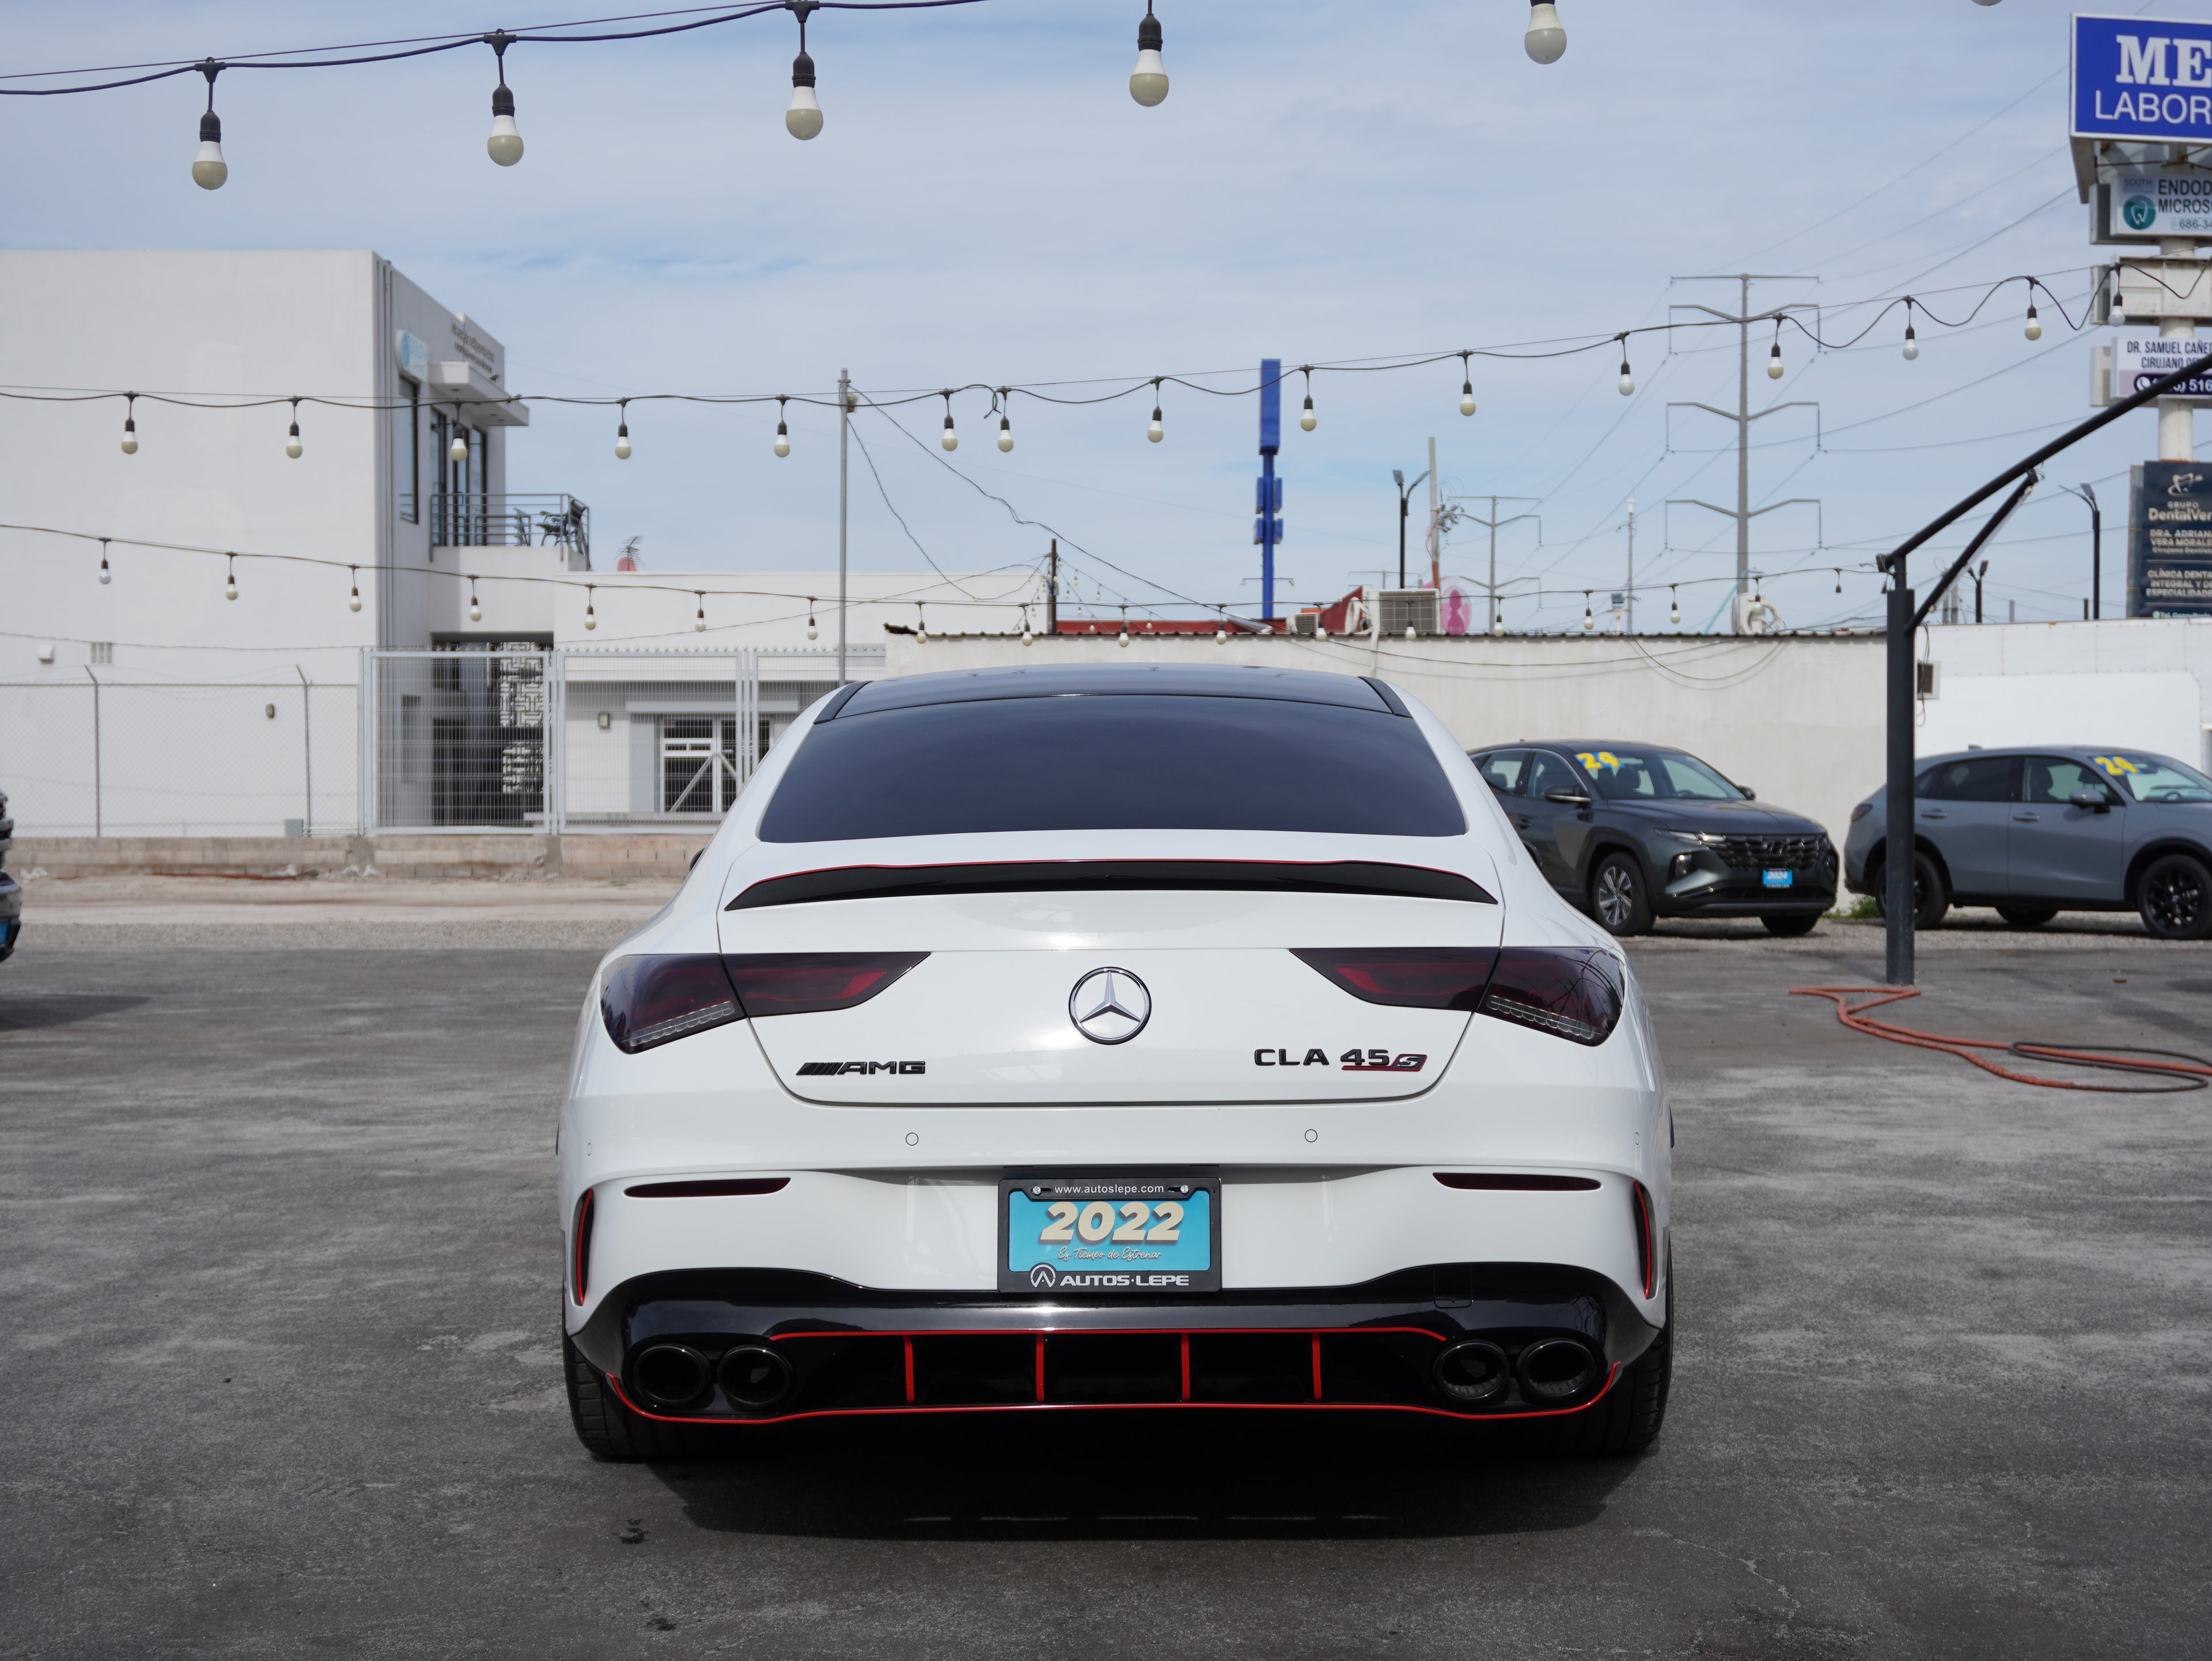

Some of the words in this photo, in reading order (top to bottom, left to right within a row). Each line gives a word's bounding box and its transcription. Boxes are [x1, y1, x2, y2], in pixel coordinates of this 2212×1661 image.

[2115, 34, 2212, 88] ME
[2095, 89, 2212, 125] LABOR
[2158, 179, 2212, 196] ENDOD
[2158, 199, 2212, 214] MICROS
[2127, 341, 2142, 353] DR.
[2145, 341, 2181, 353] SAMUEL
[2141, 357, 2183, 369] CIRUJANO
[2174, 529, 2212, 538] ADRIAN
[2150, 580, 2194, 588] INTEGRAL
[2195, 580, 2200, 588] Y
[1254, 1049, 1330, 1066] CLA
[837, 1061, 926, 1075] AMG
[1054, 1185, 1164, 1195] www.autoslepe.com
[1039, 1201, 1184, 1242] 2022
[1058, 1246, 1070, 1261] Es
[1074, 1247, 1105, 1261] Tiempo
[1107, 1250, 1120, 1259] de
[1122, 1246, 1162, 1261] Estrenar
